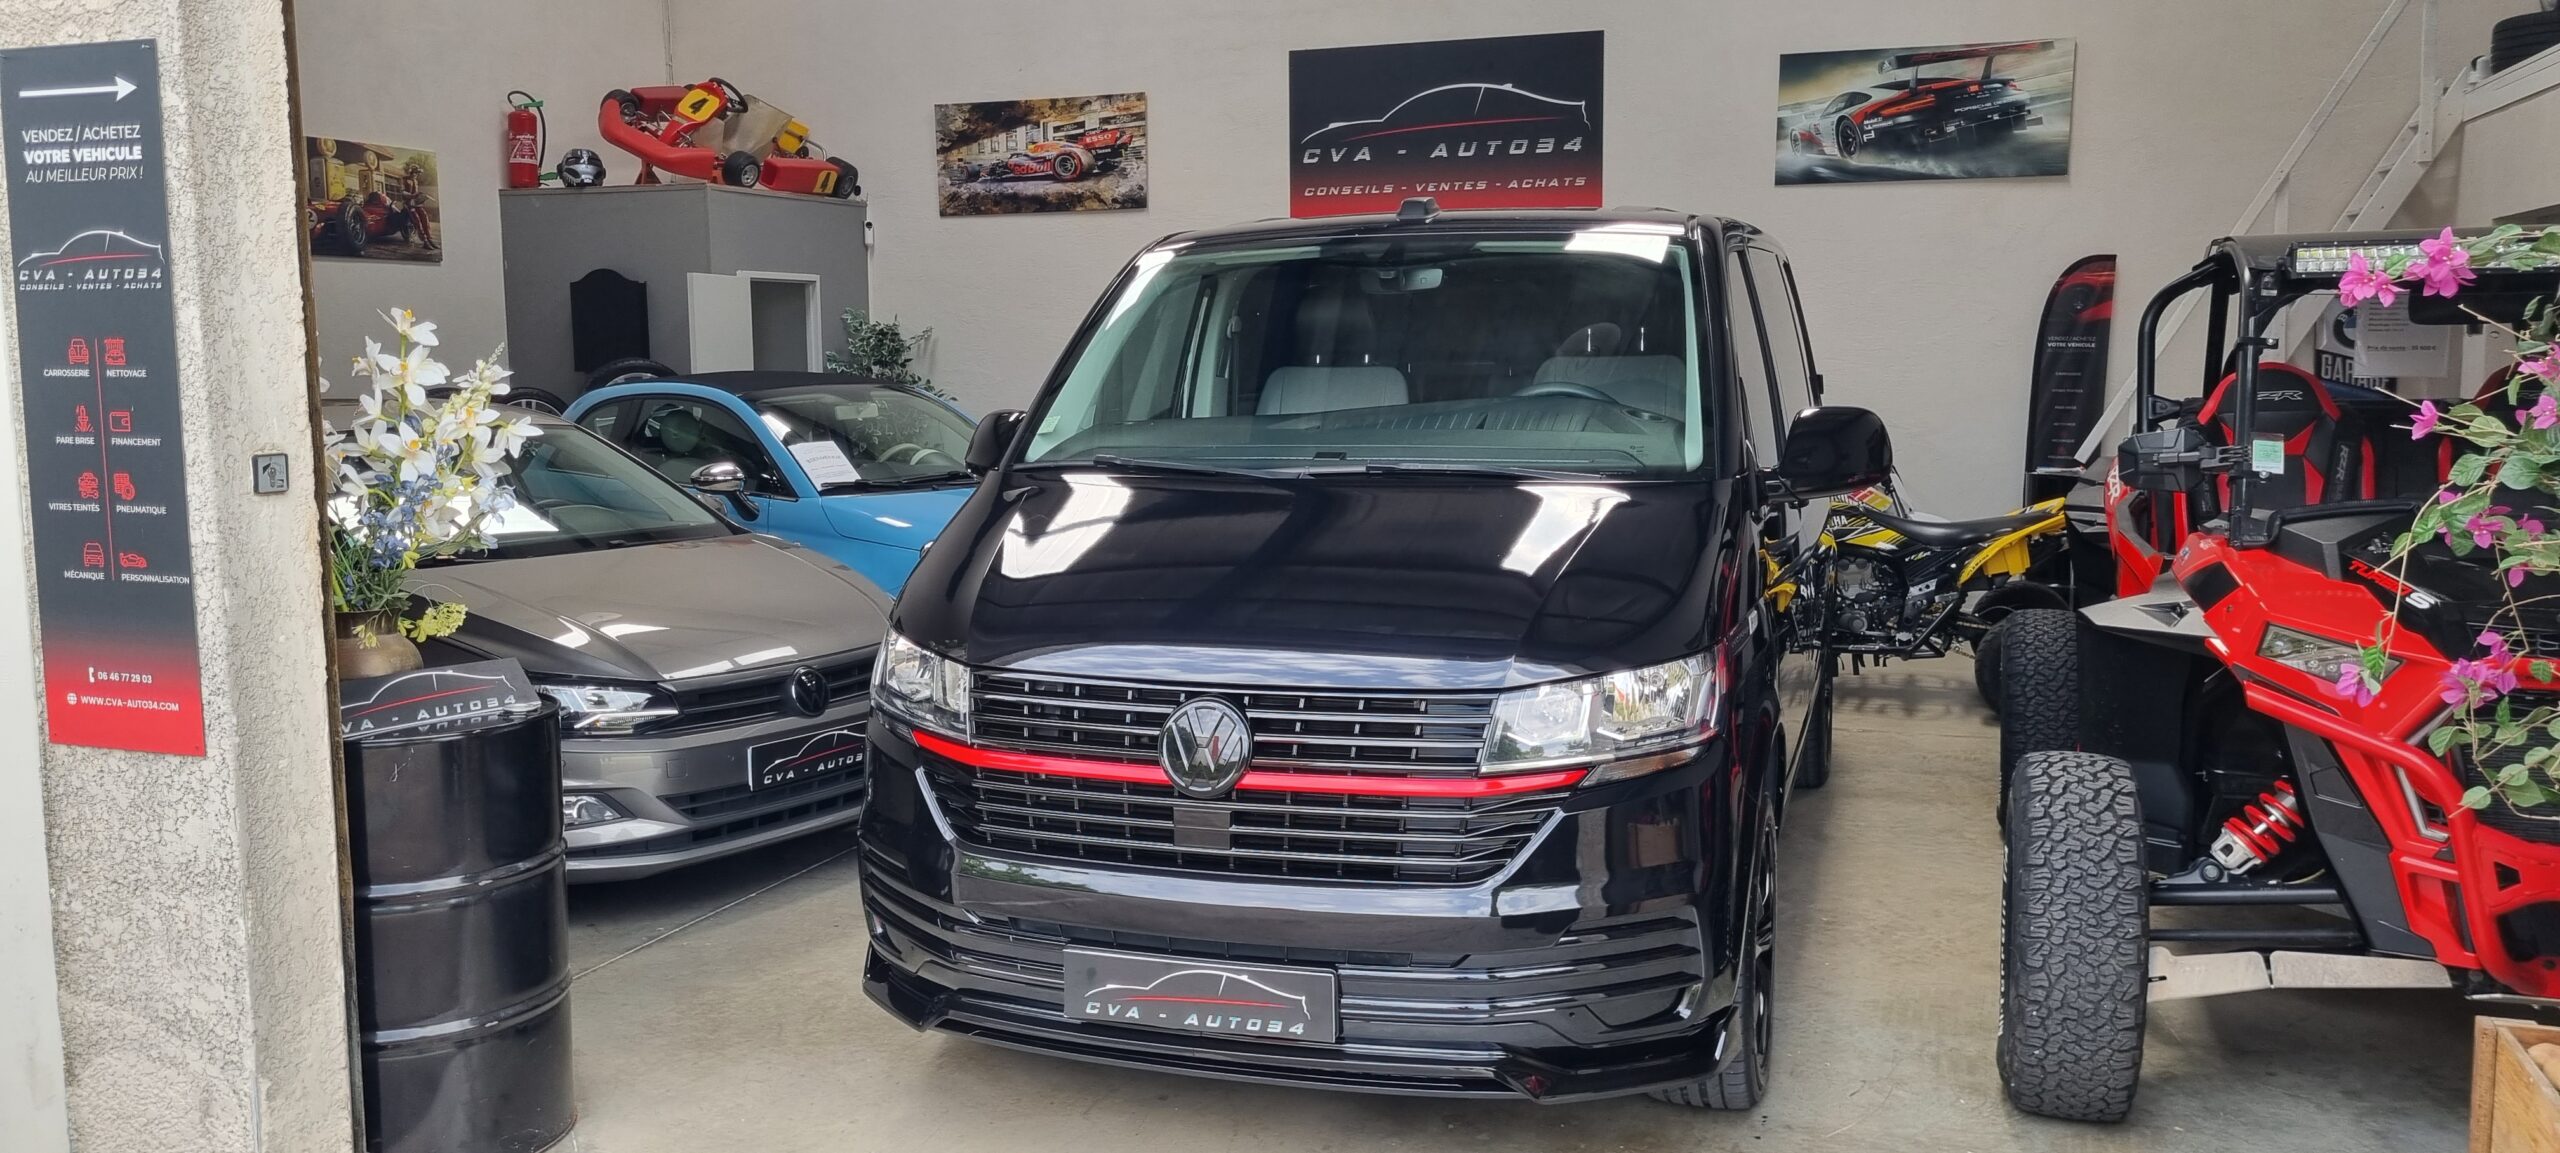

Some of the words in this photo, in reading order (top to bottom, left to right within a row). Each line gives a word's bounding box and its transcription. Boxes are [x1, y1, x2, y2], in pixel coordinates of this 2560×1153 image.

[688, 98, 709, 115] 4
[22, 128, 73, 143] VENDEZ
[83, 125, 141, 140] ACHETEZ
[23, 149, 71, 164] VOTRE
[73, 145, 143, 162] VEHICULE
[1303, 147, 1371, 164] CVA
[1430, 137, 1582, 158] AUTO34
[26, 170, 43, 183] AU
[46, 168, 106, 182] MEILLEUR
[109, 166, 137, 180] PRIX
[819, 171, 832, 193] 4
[1304, 184, 1394, 197] CONSEILS
[1415, 180, 1488, 192] VENTES
[1507, 176, 1587, 189] ACHATS
[19, 270, 56, 281] CVA
[84, 268, 162, 280] AUTO34
[19, 283, 65, 291] CONSEILS
[43, 369, 91, 378] CARROSSERIE
[106, 369, 148, 378] NETTOYAGE
[2257, 390, 2303, 401] ZR
[56, 436, 74, 445] PARE
[75, 436, 95, 445] BRISE
[111, 437, 162, 447] FINANCEMENT
[49, 502, 72, 512] VITRES
[72, 502, 101, 513] TEINTÉS
[116, 504, 167, 515] PNEUMATIQUE
[64, 569, 105, 580] MÉCANIQUE
[121, 573, 190, 584] PERSONNALISATION
[2405, 592, 2436, 609] S
[98, 671, 108, 680] 06
[109, 672, 119, 682] 46
[121, 673, 129, 683] 77
[131, 673, 140, 683] 29
[142, 674, 152, 684] 03
[80, 695, 180, 712] WWW.CVA-AUTO34.COM
[341, 718, 375, 734] VA
[417, 695, 516, 720] AUTO34
[764, 770, 795, 784] CVA
[817, 753, 863, 771] AUTO3
[1085, 1002, 1140, 1019] CVA
[1184, 1014, 1304, 1035] AUTO34
